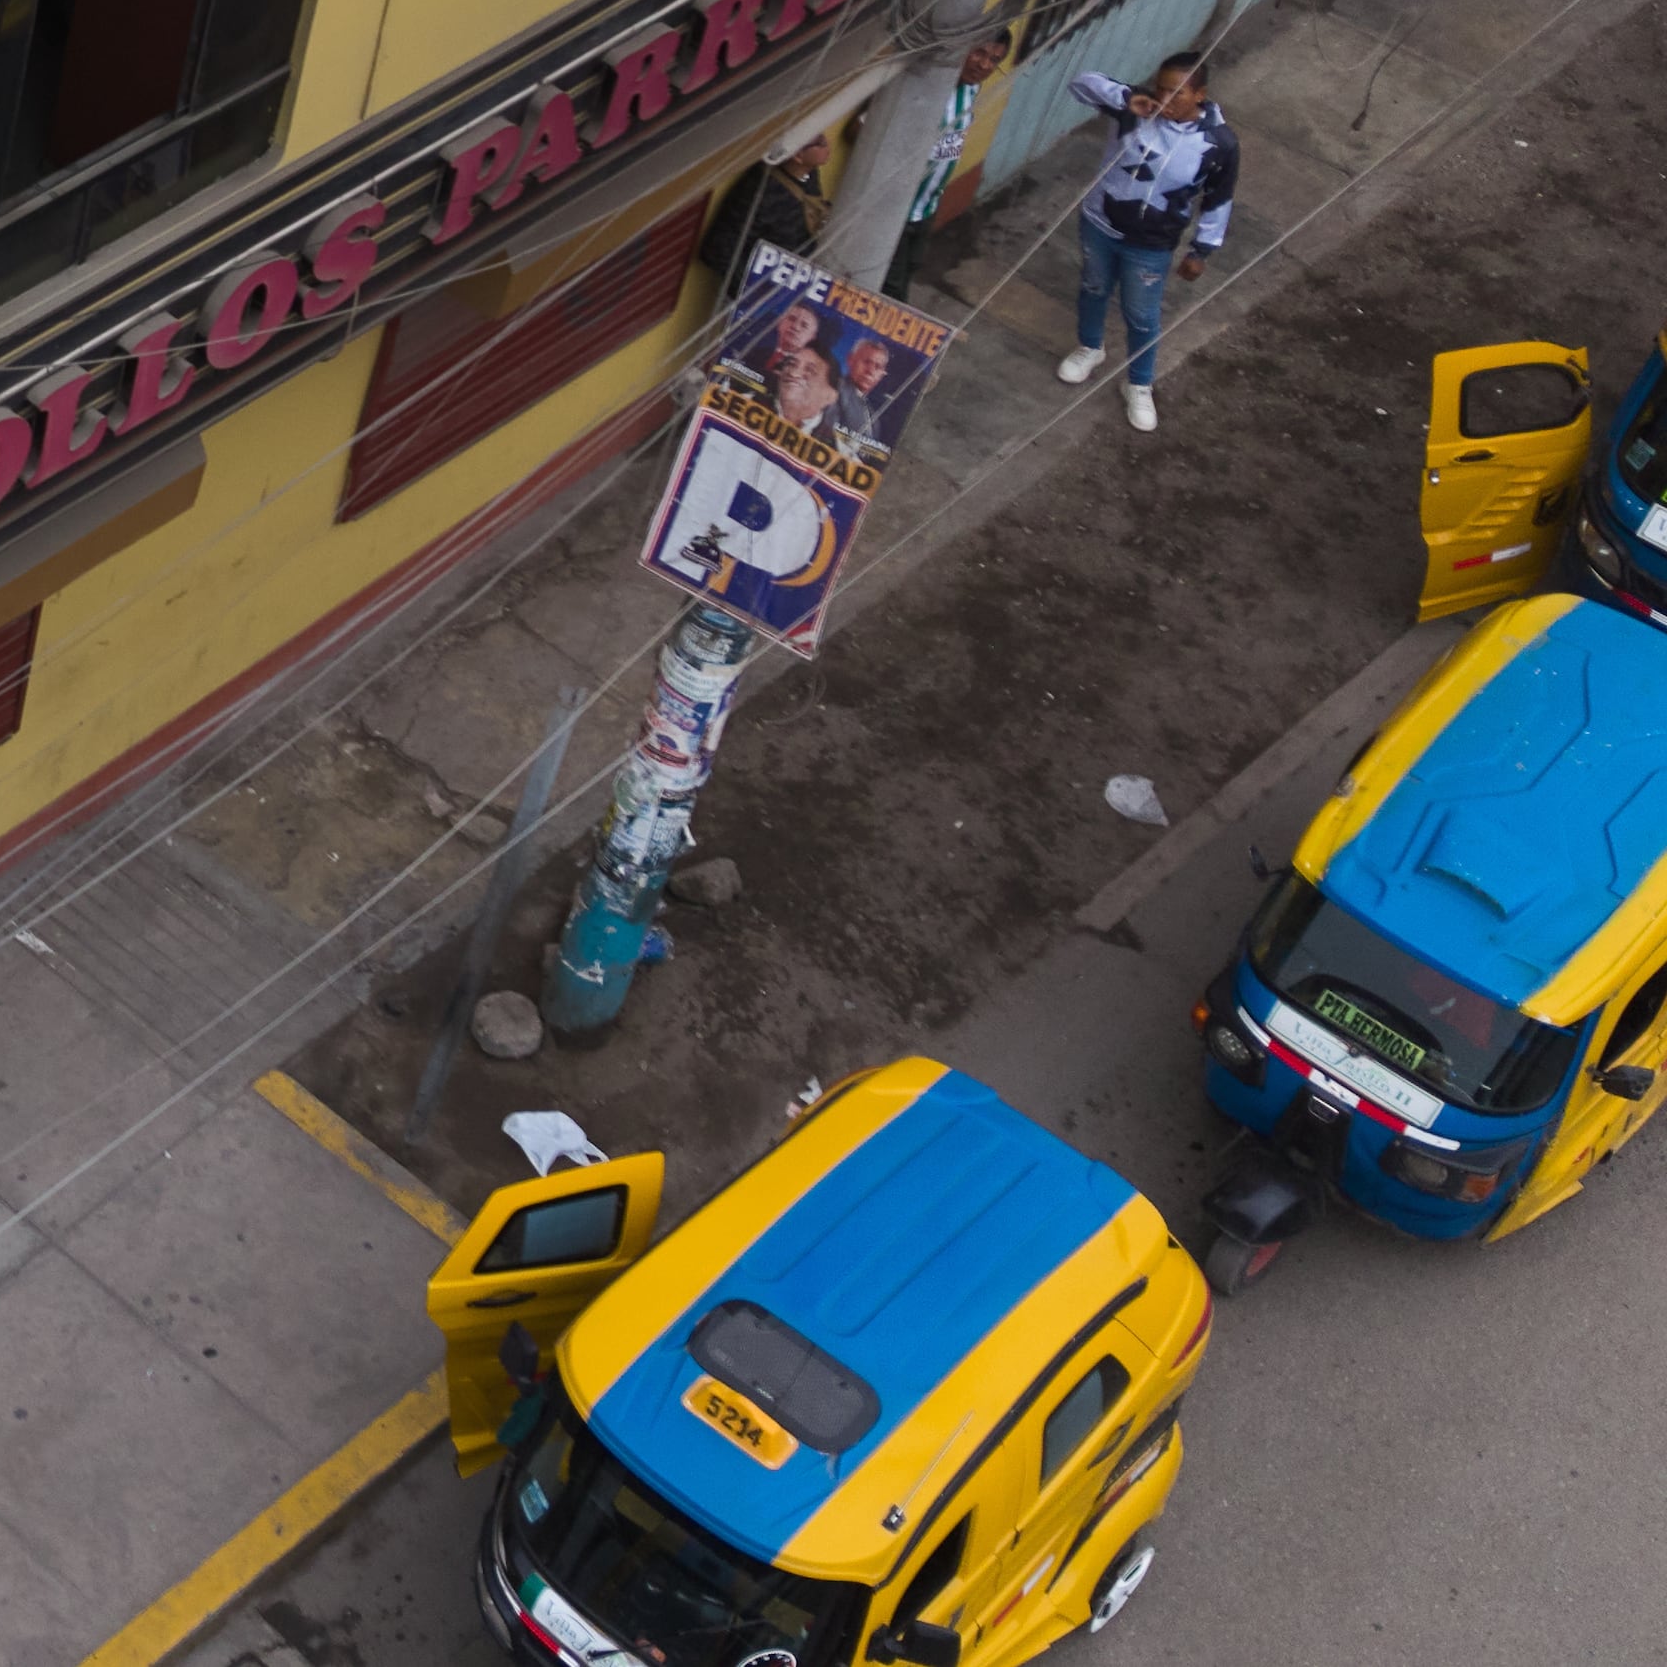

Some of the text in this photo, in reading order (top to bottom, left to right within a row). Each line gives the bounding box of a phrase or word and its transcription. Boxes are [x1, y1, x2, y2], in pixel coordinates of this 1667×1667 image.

[752, 246, 951, 358] PEPE PRESIDENTE
[708, 385, 874, 494] SEGURIDAD
[659, 427, 821, 583] P
[705, 1394, 765, 1448] 5214
